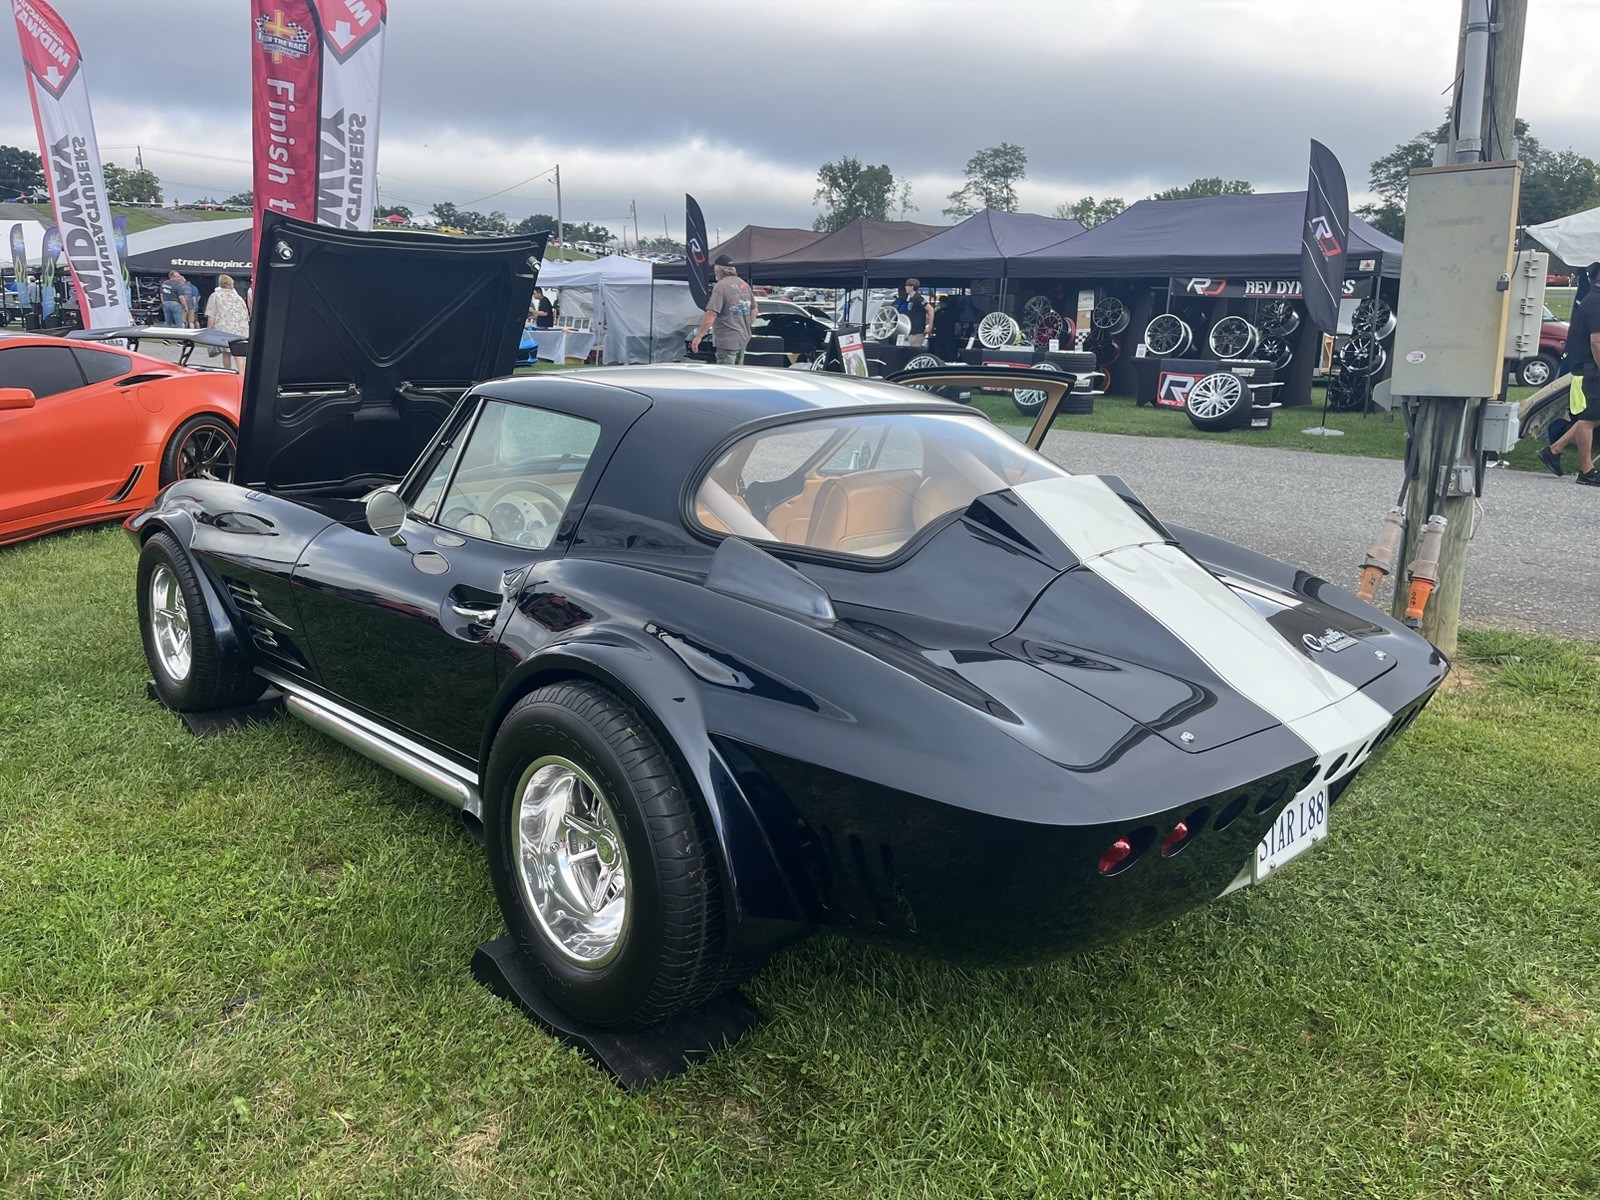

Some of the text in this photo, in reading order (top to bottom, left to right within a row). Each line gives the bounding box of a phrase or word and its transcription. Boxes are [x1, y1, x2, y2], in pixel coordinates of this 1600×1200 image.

[267, 77, 296, 185] Finish
[1245, 280, 1272, 294] REV
[1260, 790, 1324, 862] STAR L88
